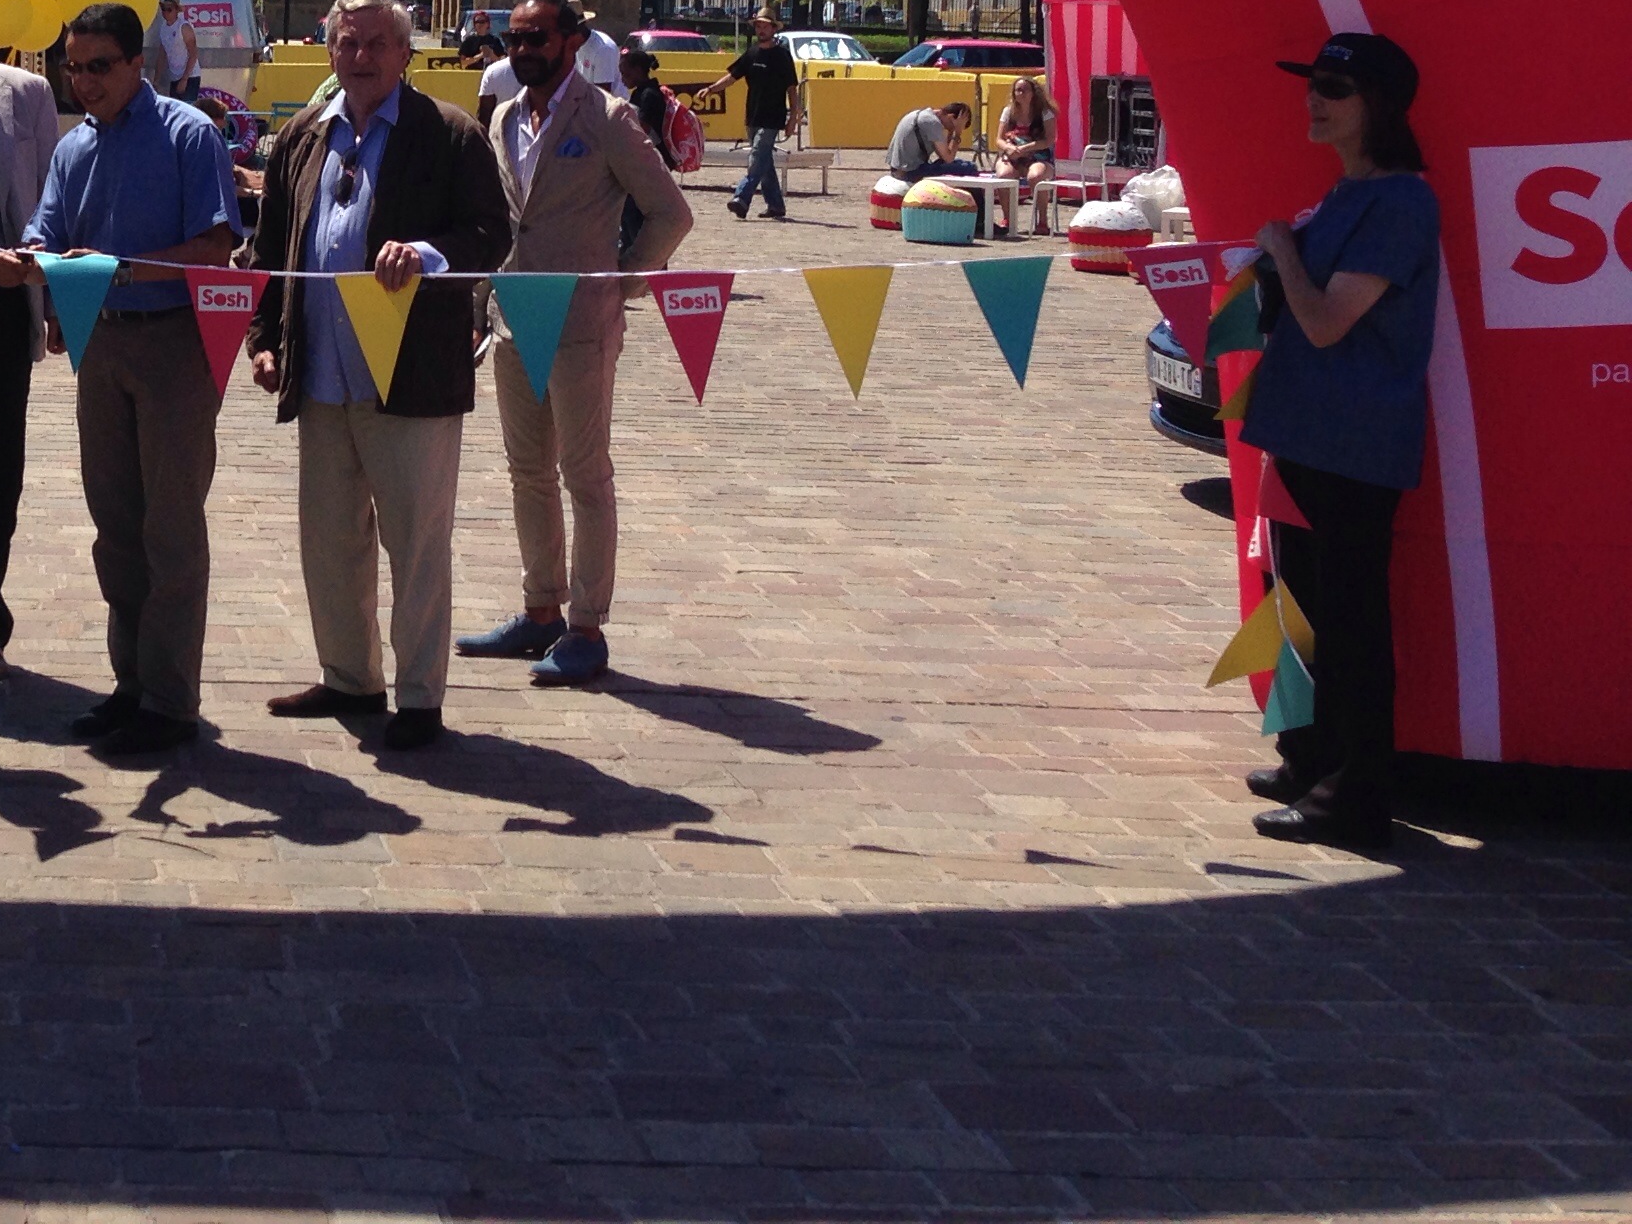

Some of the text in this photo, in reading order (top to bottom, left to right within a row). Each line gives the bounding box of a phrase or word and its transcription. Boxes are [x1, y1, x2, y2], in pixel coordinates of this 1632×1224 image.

[188, 7, 231, 24] Sosh
[1151, 265, 1204, 285] Sosh
[201, 288, 250, 308] Sosh
[667, 290, 718, 312] Sosh
